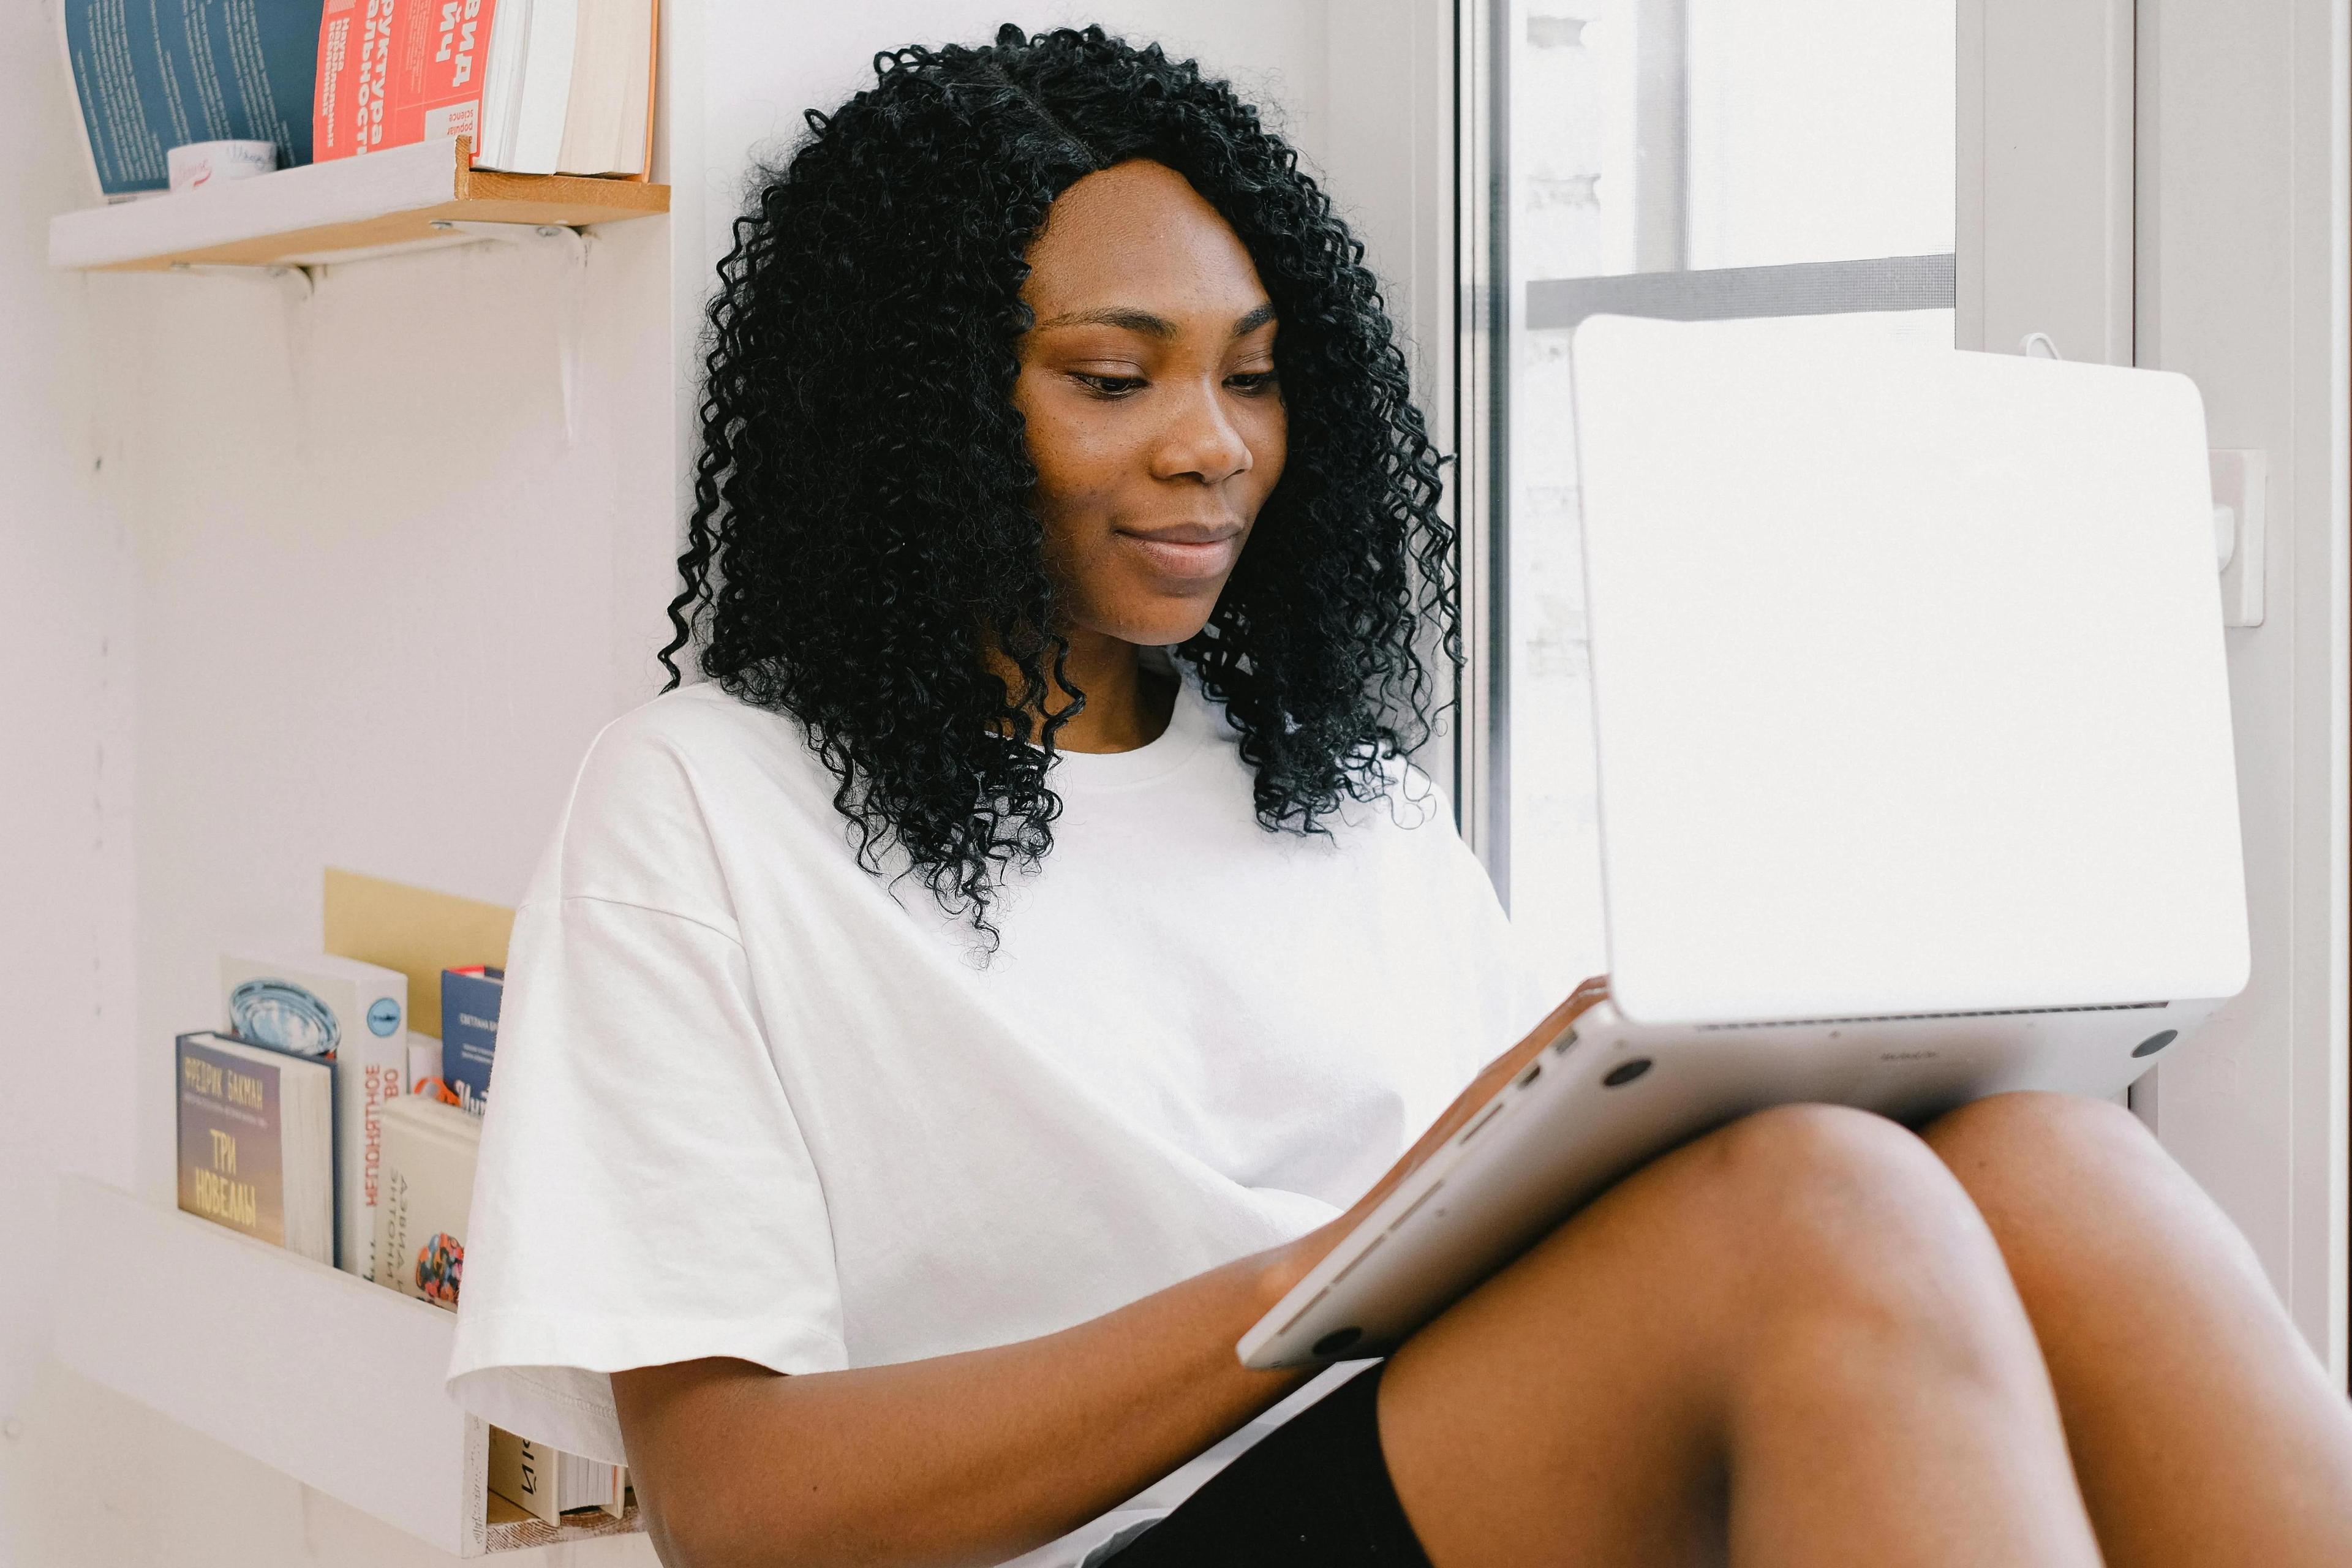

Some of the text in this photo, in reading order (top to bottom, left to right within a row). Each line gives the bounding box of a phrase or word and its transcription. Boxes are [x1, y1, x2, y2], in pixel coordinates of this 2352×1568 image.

[337, 17, 350, 72] Наука
[447, 119, 473, 135] popular
[449, 110, 474, 122] science
[185, 1057, 223, 1098] ФРЕДРИК
[227, 1068, 263, 1111] БАКМАН
[384, 1068, 399, 1102] ВО
[210, 1128, 237, 1176] ТРИ
[365, 1065, 380, 1207] НЕПОНЯТНОЕ
[195, 1166, 257, 1228] НОВЕЛЛЫ
[386, 1168, 399, 1279] ЭНТОНИ
